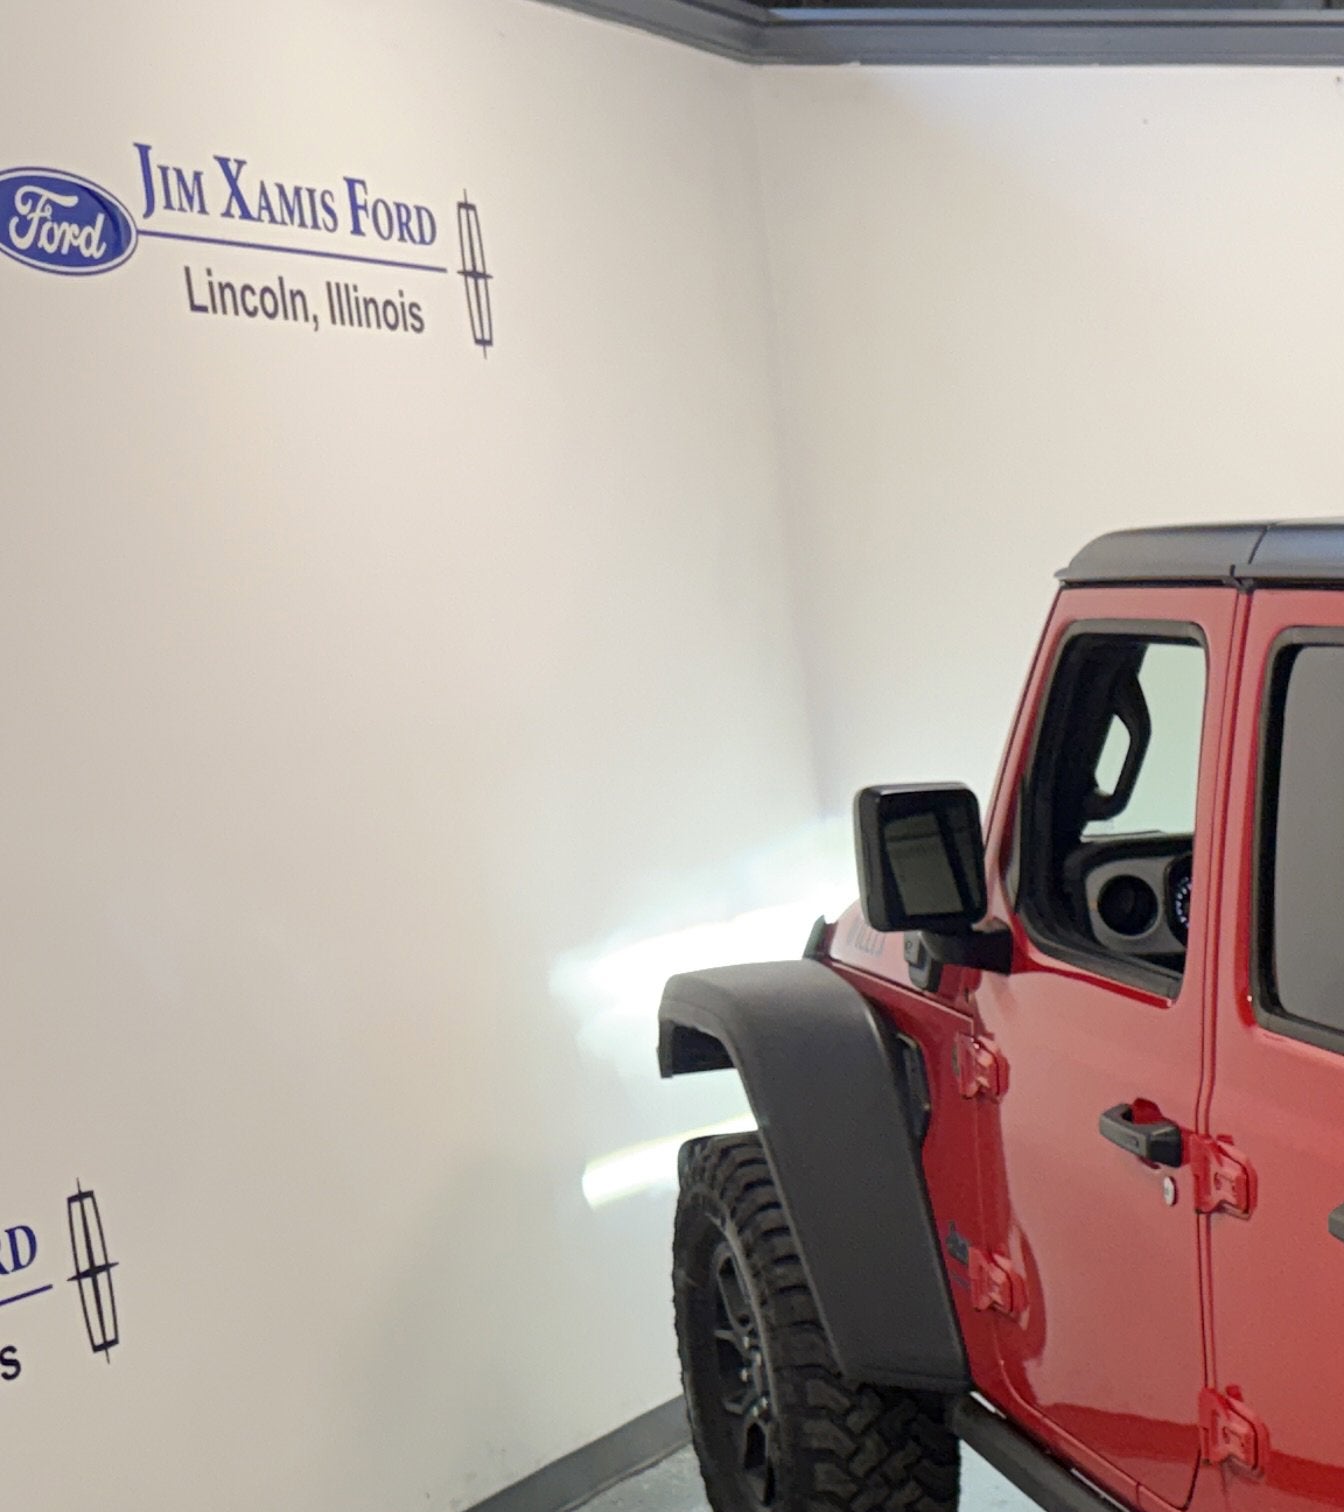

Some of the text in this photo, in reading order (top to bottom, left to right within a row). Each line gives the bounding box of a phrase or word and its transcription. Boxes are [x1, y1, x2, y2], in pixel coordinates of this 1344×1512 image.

[8, 184, 108, 260] Ford
[133, 142, 437, 246] JIM XAMIS FORD
[184, 265, 425, 334] Lincoln, Illinois
[0, 1225, 38, 1275] D
